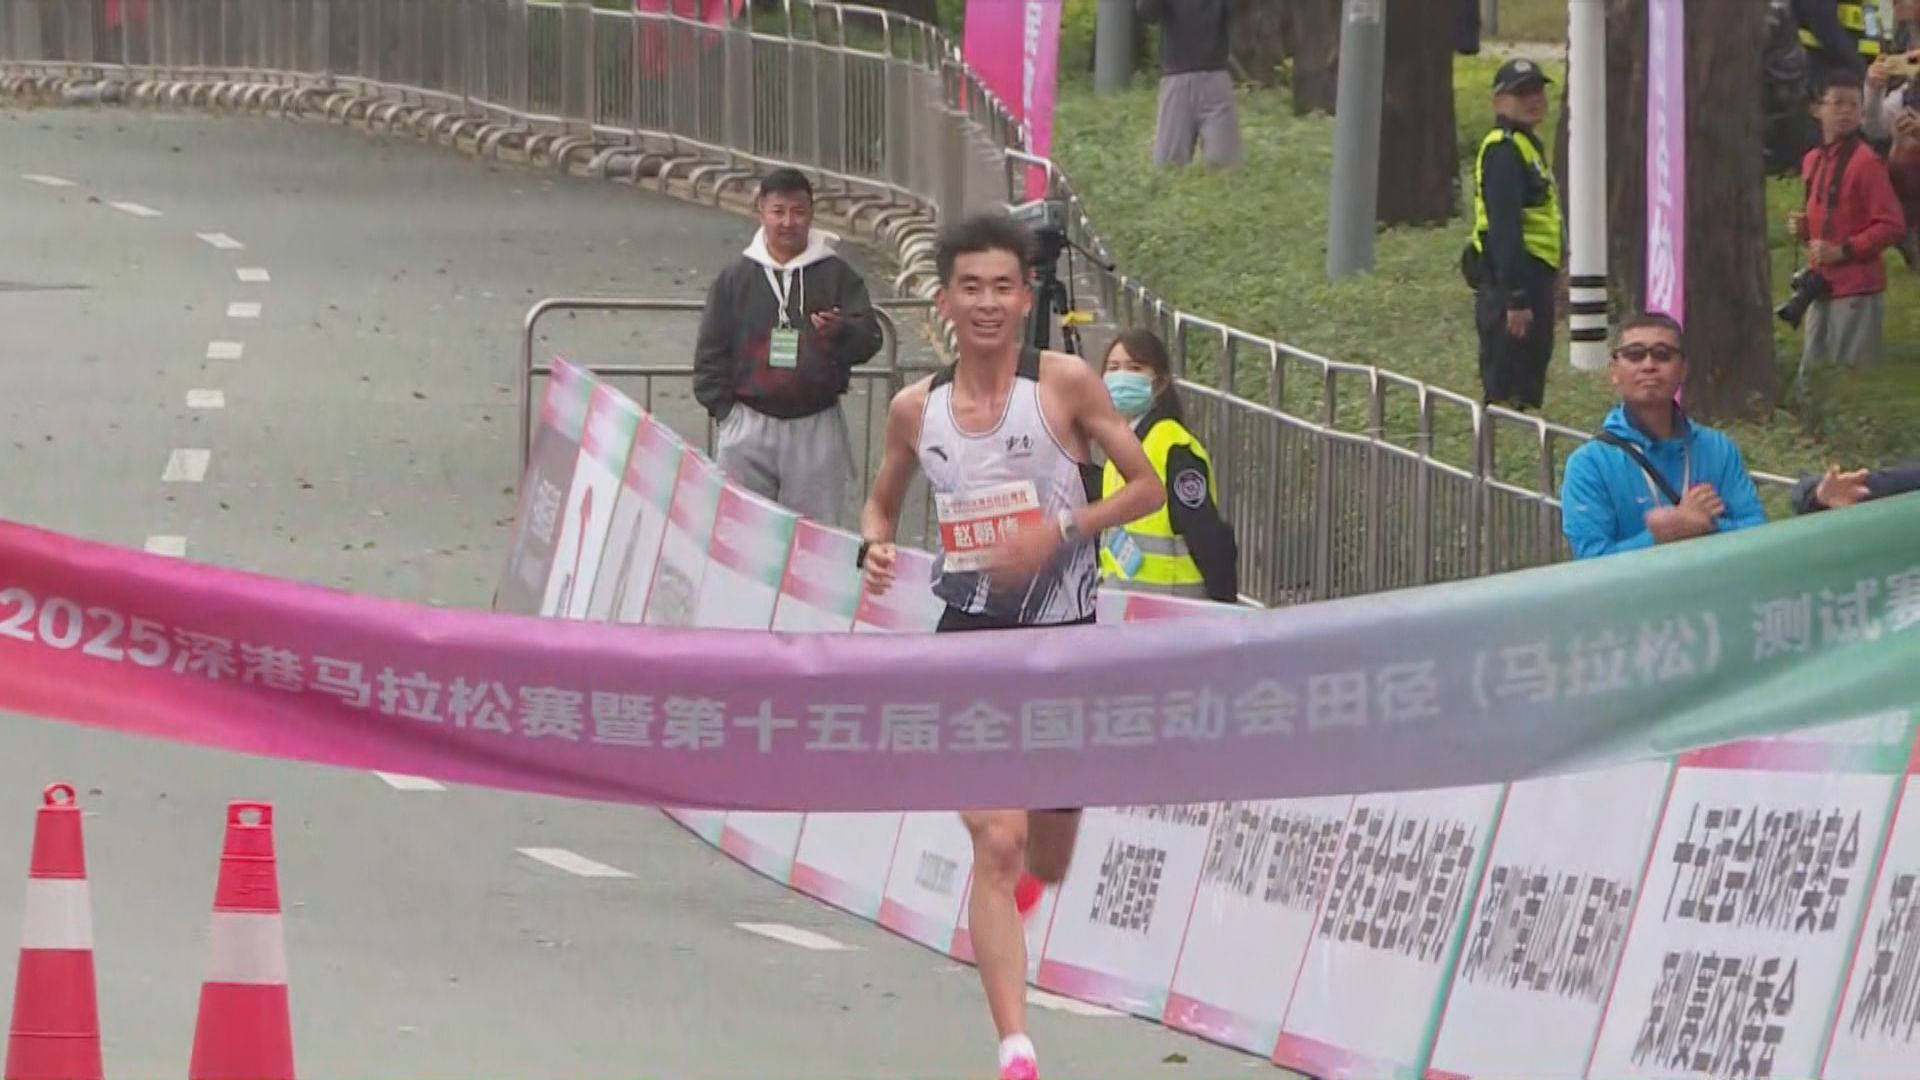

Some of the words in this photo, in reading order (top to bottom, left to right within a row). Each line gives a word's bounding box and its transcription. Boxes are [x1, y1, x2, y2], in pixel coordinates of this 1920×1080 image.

[1319, 807, 1477, 963] 香港全运会统筹办
[1664, 802, 1861, 933] 十五运会和残特奥会
[1631, 950, 1798, 1077] 深圳赛区执委会
